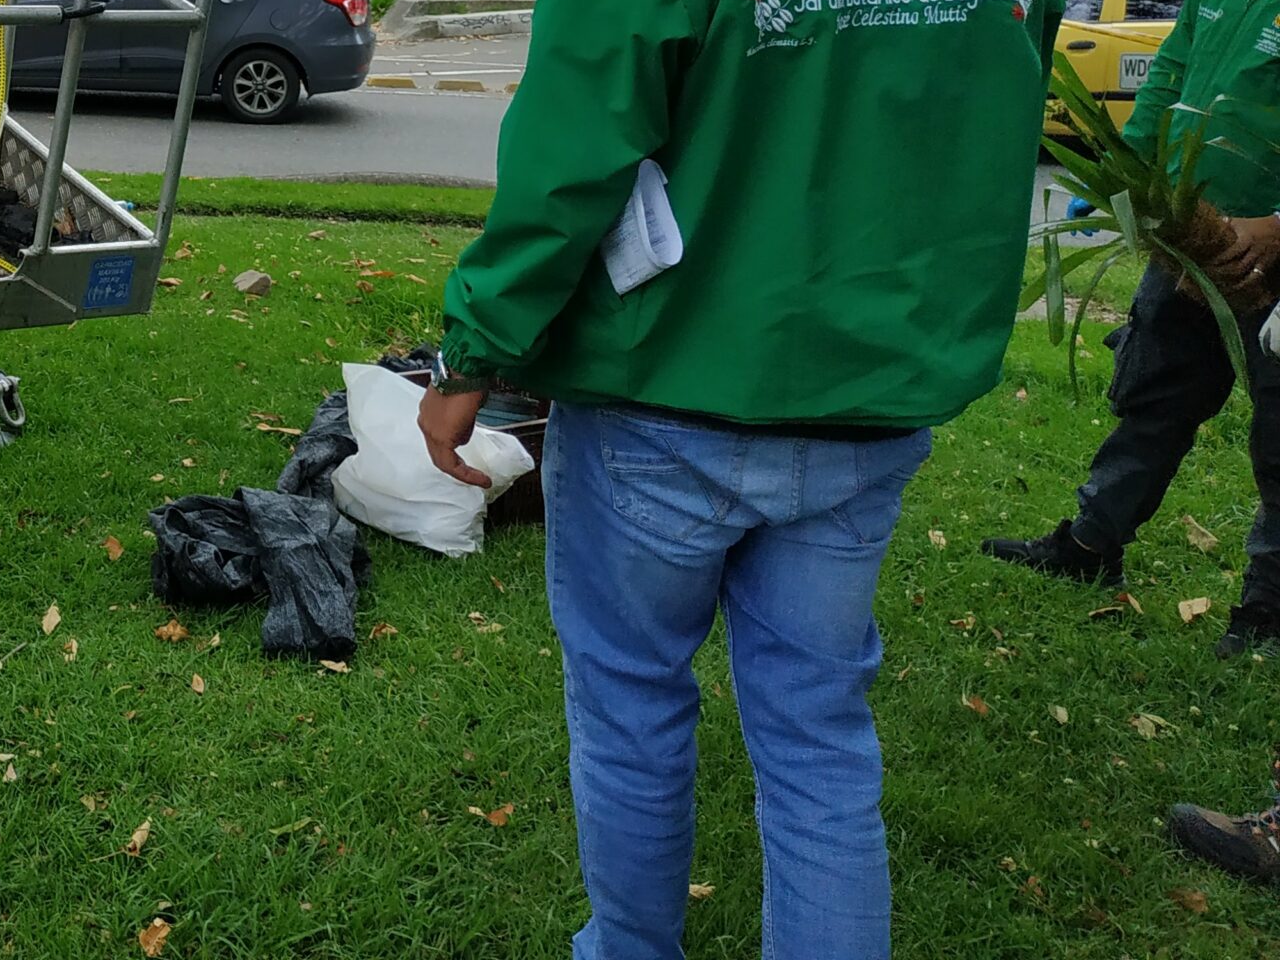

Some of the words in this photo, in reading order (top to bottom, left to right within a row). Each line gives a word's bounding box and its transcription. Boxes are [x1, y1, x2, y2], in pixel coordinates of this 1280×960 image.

[851, 5, 919, 28] Celestino
[923, 1, 968, 25] Mutis
[1124, 59, 1153, 77] WD
